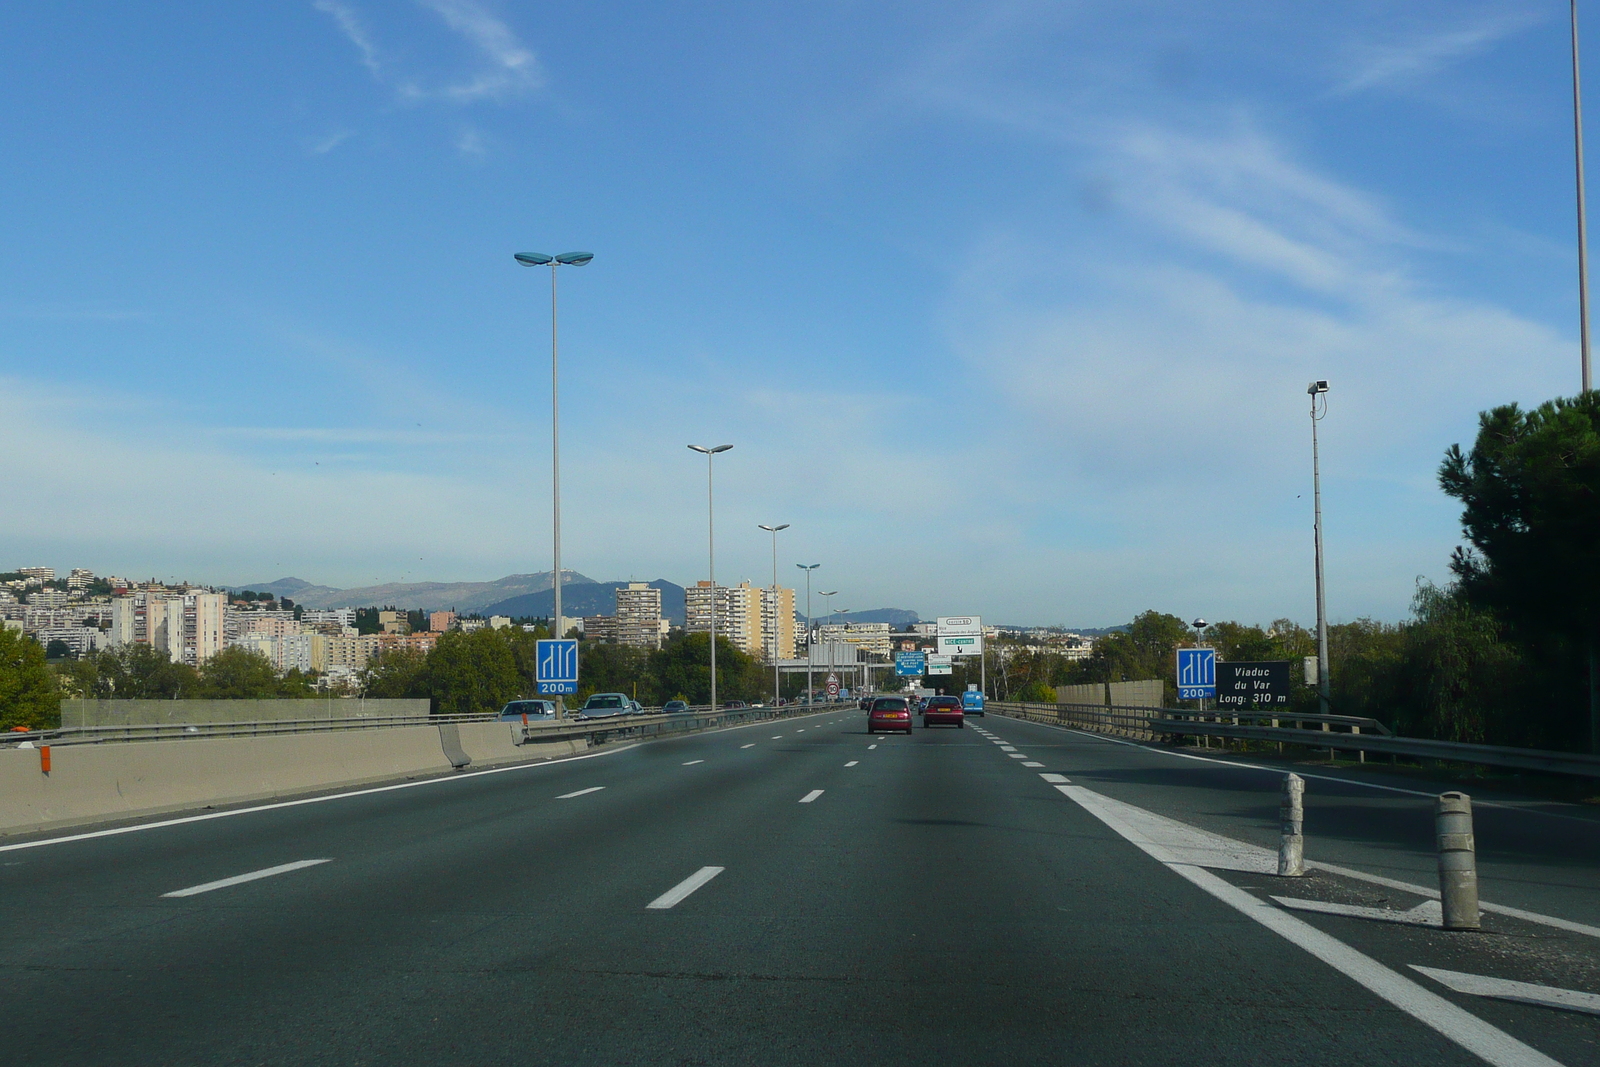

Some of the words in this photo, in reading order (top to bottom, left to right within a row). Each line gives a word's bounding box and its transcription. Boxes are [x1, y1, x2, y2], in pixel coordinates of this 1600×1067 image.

[1234, 667, 1270, 677] Viaduc
[1234, 680, 1247, 690] du
[1253, 680, 1271, 690] Var
[1252, 693, 1272, 703] 310
[1277, 695, 1287, 703] m
